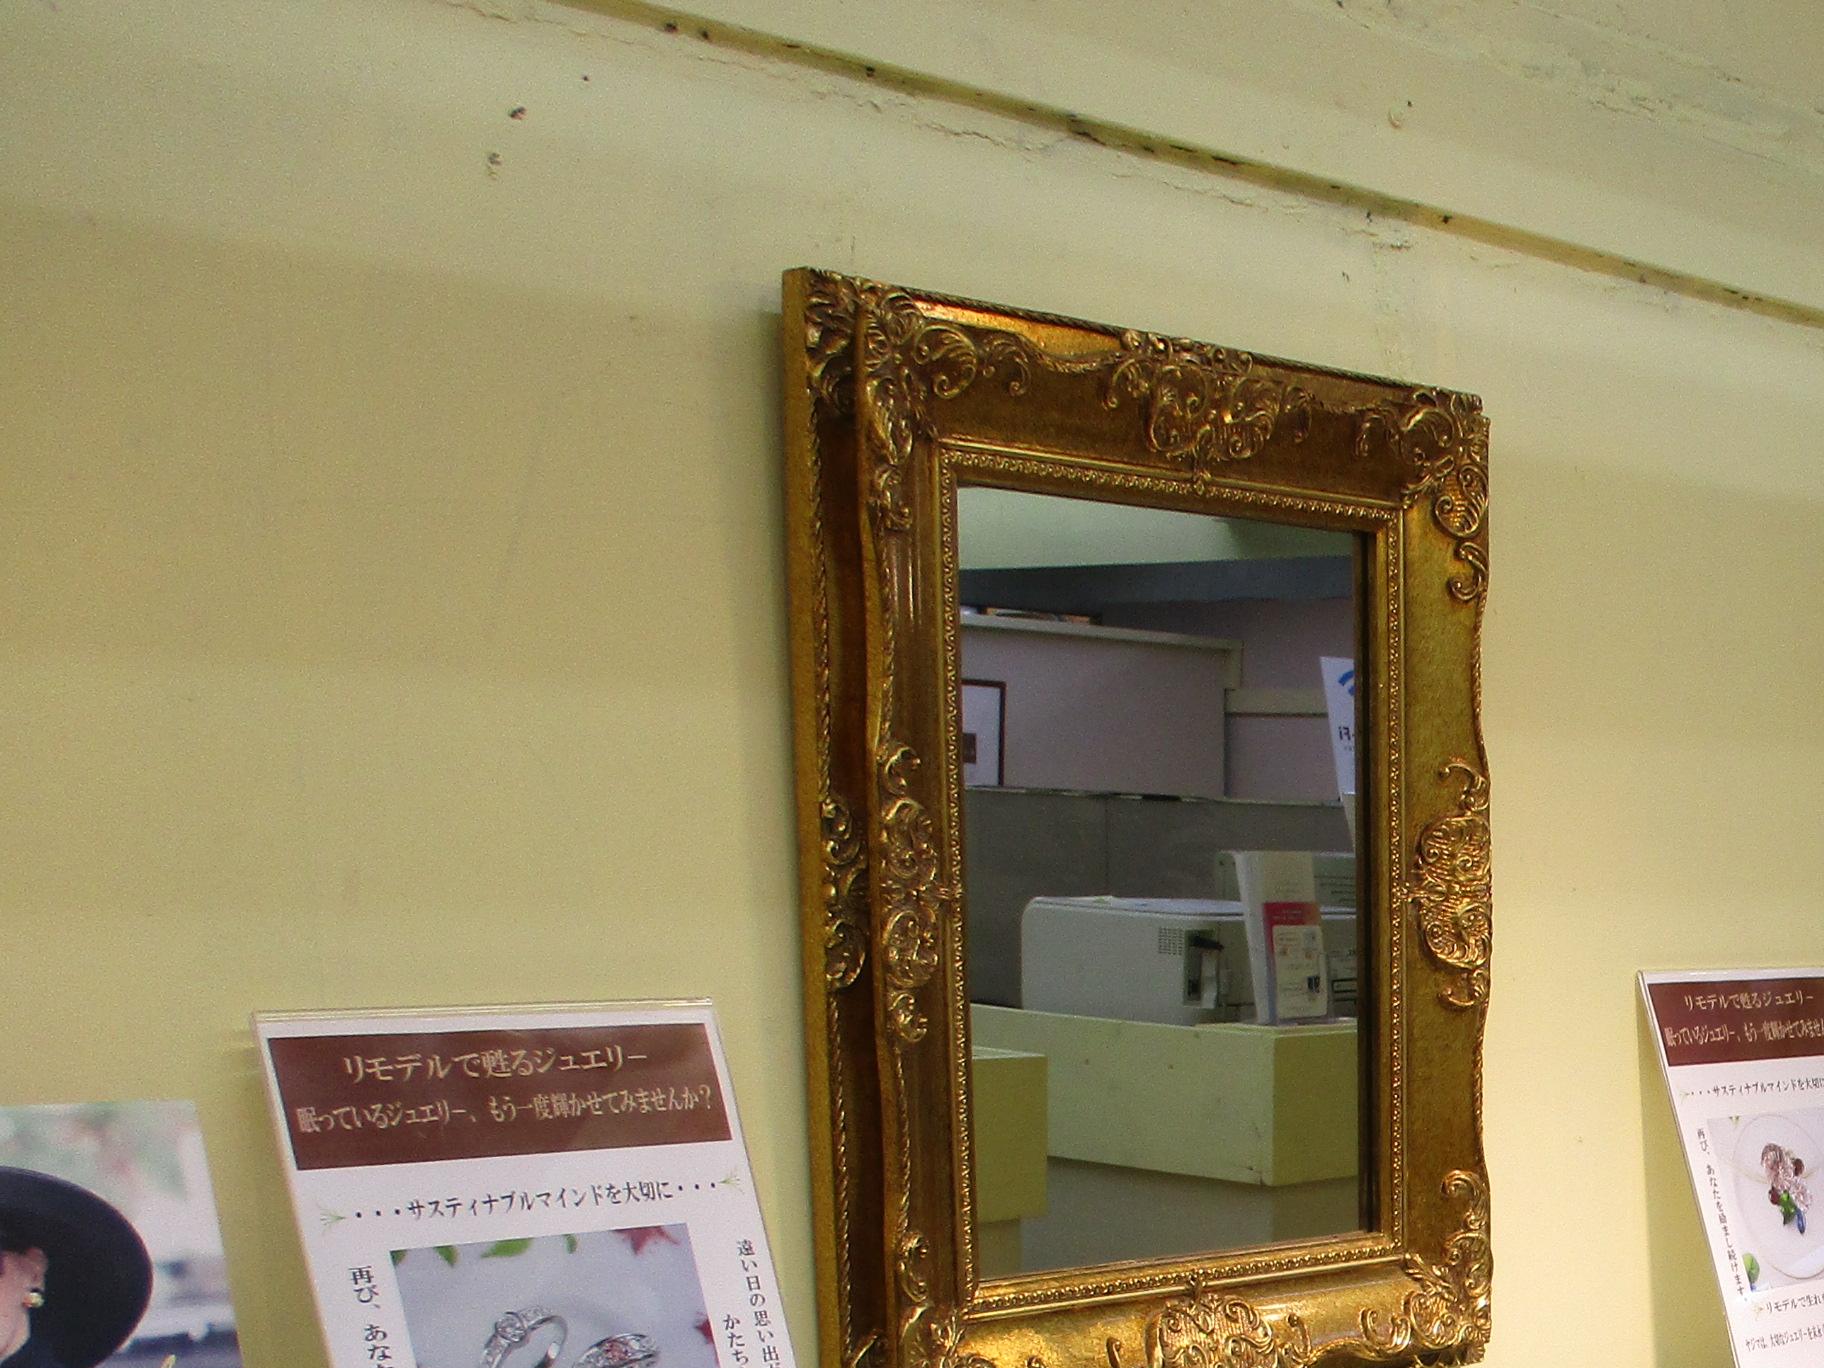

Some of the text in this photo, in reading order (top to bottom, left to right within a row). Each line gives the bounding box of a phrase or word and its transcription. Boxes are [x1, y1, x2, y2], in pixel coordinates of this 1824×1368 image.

[1684, 990, 1814, 1012] リモデルで甦るジュエリー
[342, 1044, 648, 1084] リモデルで甦るジュエリー
